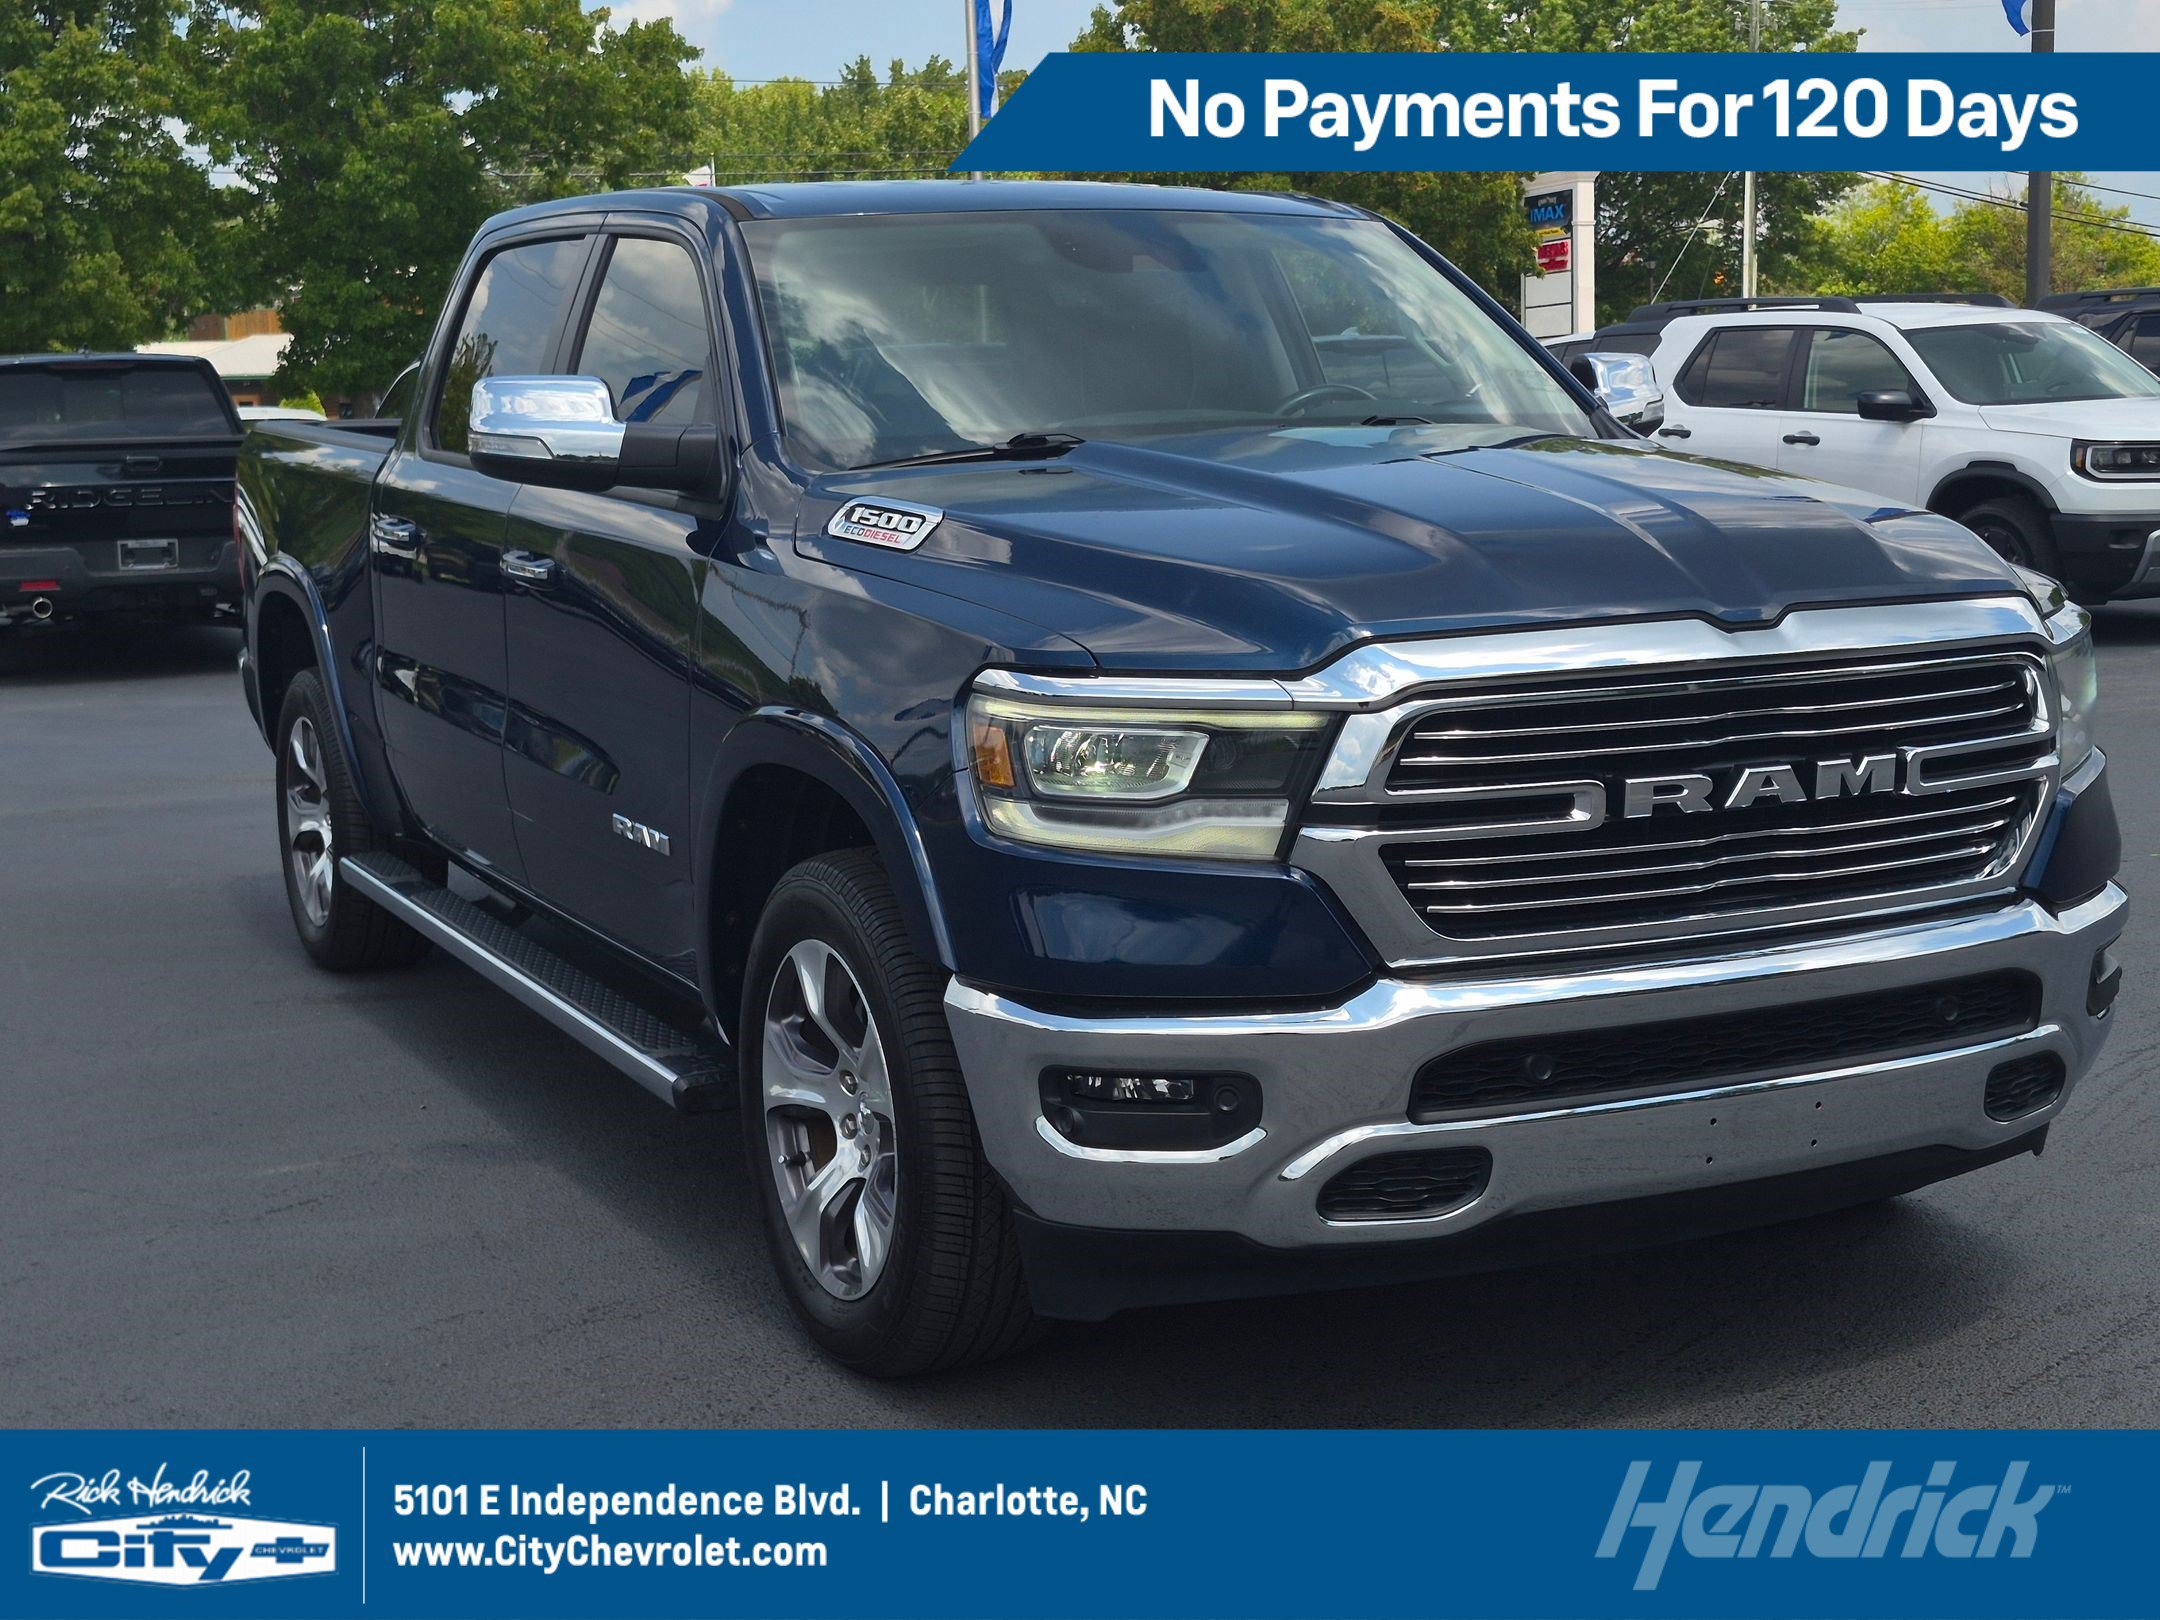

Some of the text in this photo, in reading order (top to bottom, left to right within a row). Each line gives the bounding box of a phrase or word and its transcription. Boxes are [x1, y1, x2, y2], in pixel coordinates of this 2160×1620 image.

[843, 525, 901, 544] ECODIESEL
[850, 506, 923, 533] 1500
[1624, 753, 1897, 819] RAM
[612, 812, 671, 857] RAM
